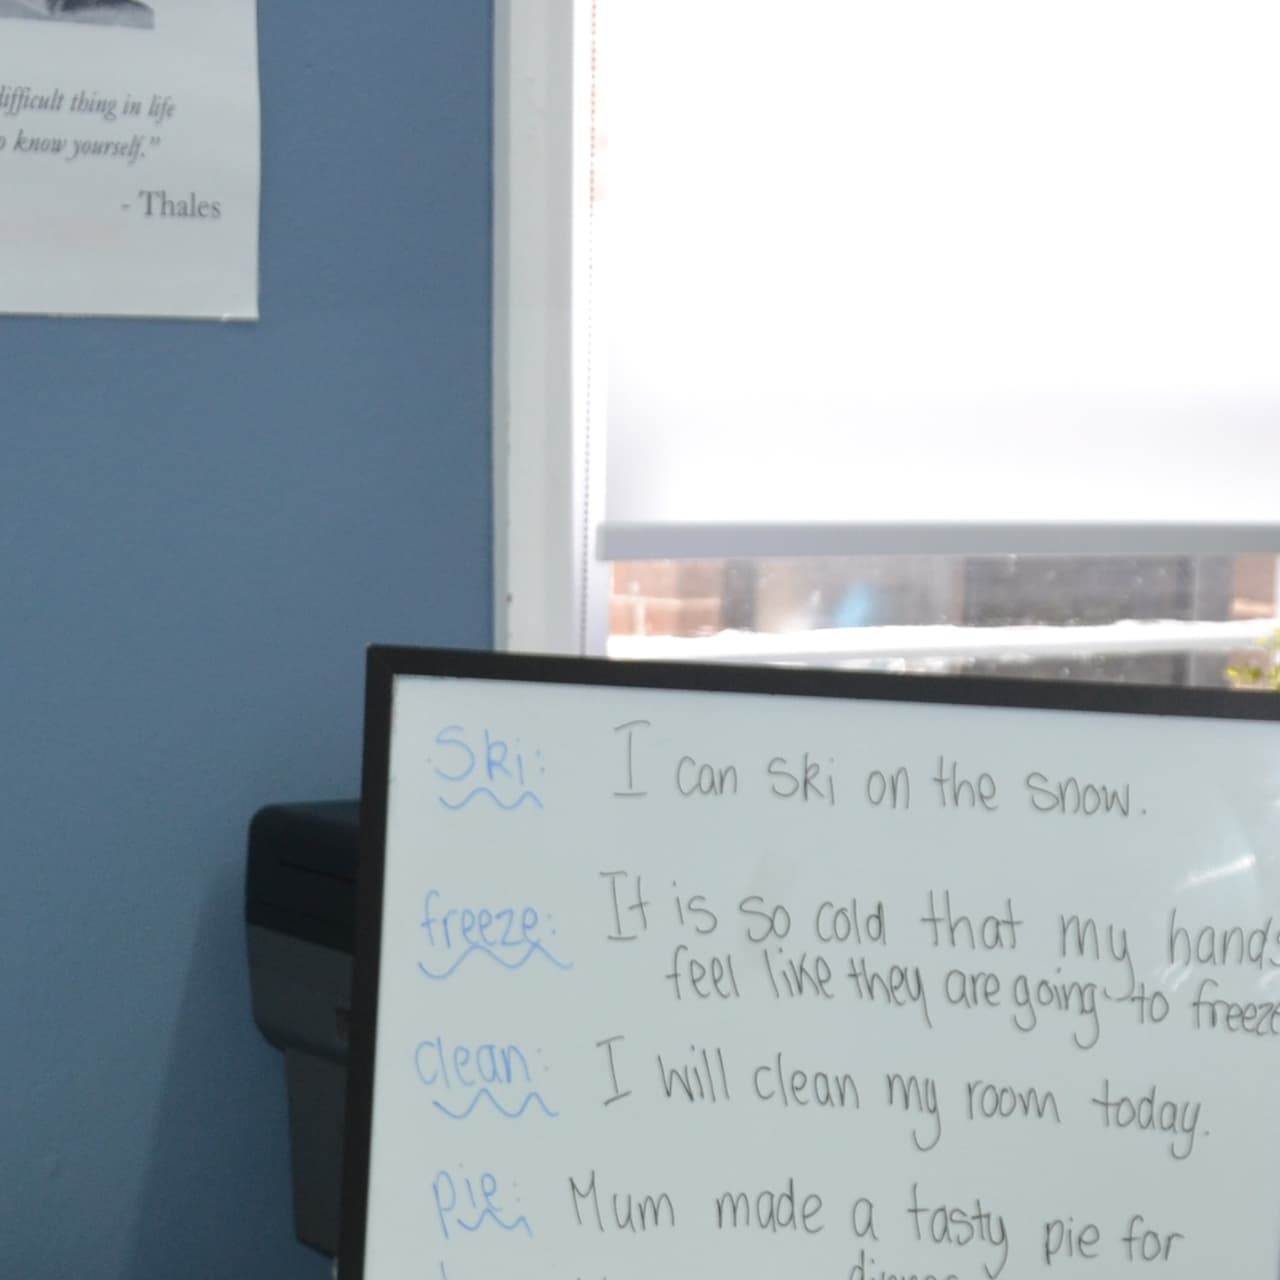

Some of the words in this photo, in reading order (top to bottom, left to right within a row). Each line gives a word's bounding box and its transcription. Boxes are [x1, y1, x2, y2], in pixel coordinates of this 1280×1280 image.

[14, 130, 67, 153] know
[70, 94, 117, 120] thing
[122, 100, 141, 117] in
[147, 97, 176, 121] life
[137, 190, 222, 219] Thales
[613, 719, 651, 797] I
[676, 756, 738, 797] can
[866, 766, 911, 809] on
[933, 755, 997, 812] the
[599, 870, 650, 940] It
[672, 880, 717, 934] is
[816, 897, 887, 946] cold
[920, 889, 1023, 950] that
[1059, 913, 1136, 1000] my
[665, 944, 739, 1000] feel
[763, 947, 833, 999] like
[847, 957, 933, 1029] they
[945, 969, 1001, 1009] are
[1013, 967, 1101, 1049] going
[1130, 982, 1170, 1025] to
[595, 1034, 632, 1107] I
[658, 1044, 729, 1103] will
[753, 1052, 860, 1109] clean
[886, 1072, 942, 1151] my
[967, 1079, 1061, 1123] room
[1093, 1078, 1210, 1160] today.
[569, 1169, 675, 1233] Mum
[716, 1177, 824, 1234] made
[852, 1197, 879, 1241] a
[906, 1182, 1009, 1280] tasty
[1043, 1217, 1101, 1266] pie
[1121, 1214, 1185, 1262] for
